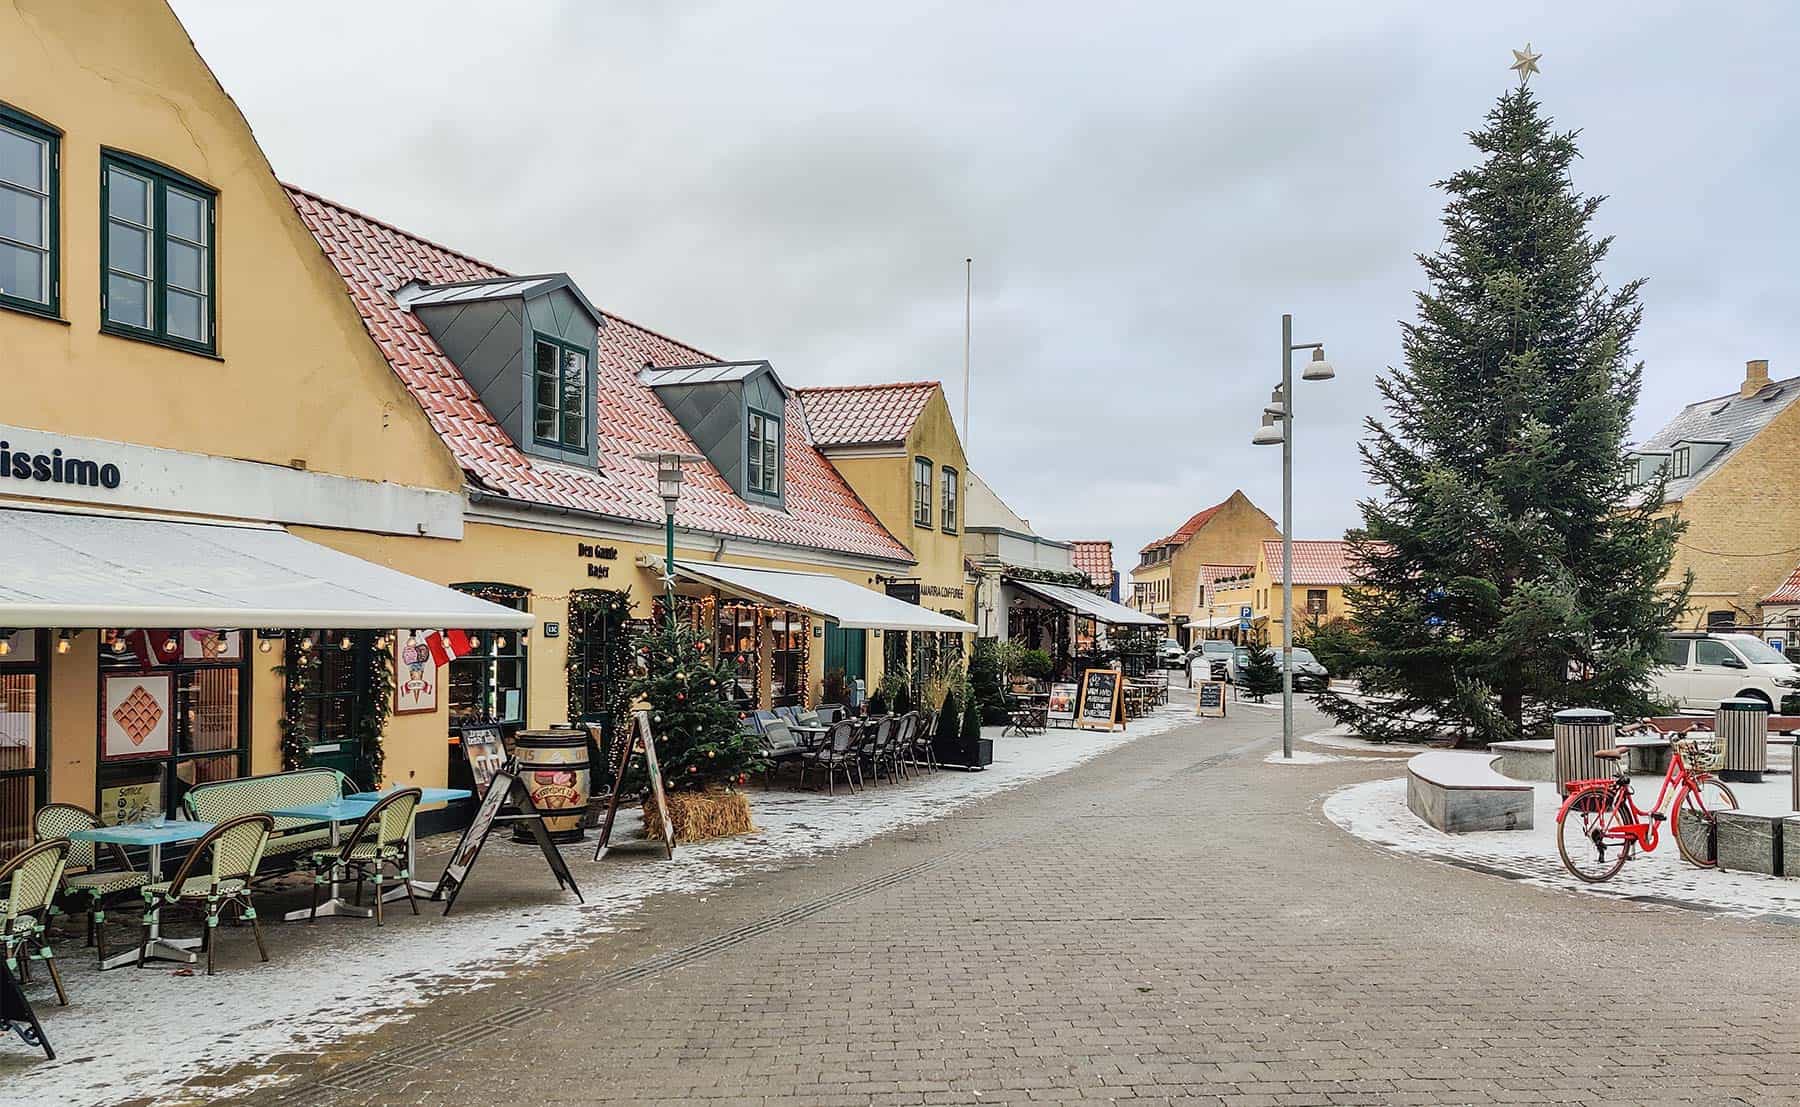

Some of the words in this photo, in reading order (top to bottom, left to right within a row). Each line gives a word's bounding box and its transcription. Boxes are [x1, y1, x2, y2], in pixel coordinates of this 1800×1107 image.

[0, 441, 120, 489] issimo
[578, 542, 594, 557] Den
[1242, 608, 1250, 617] P
